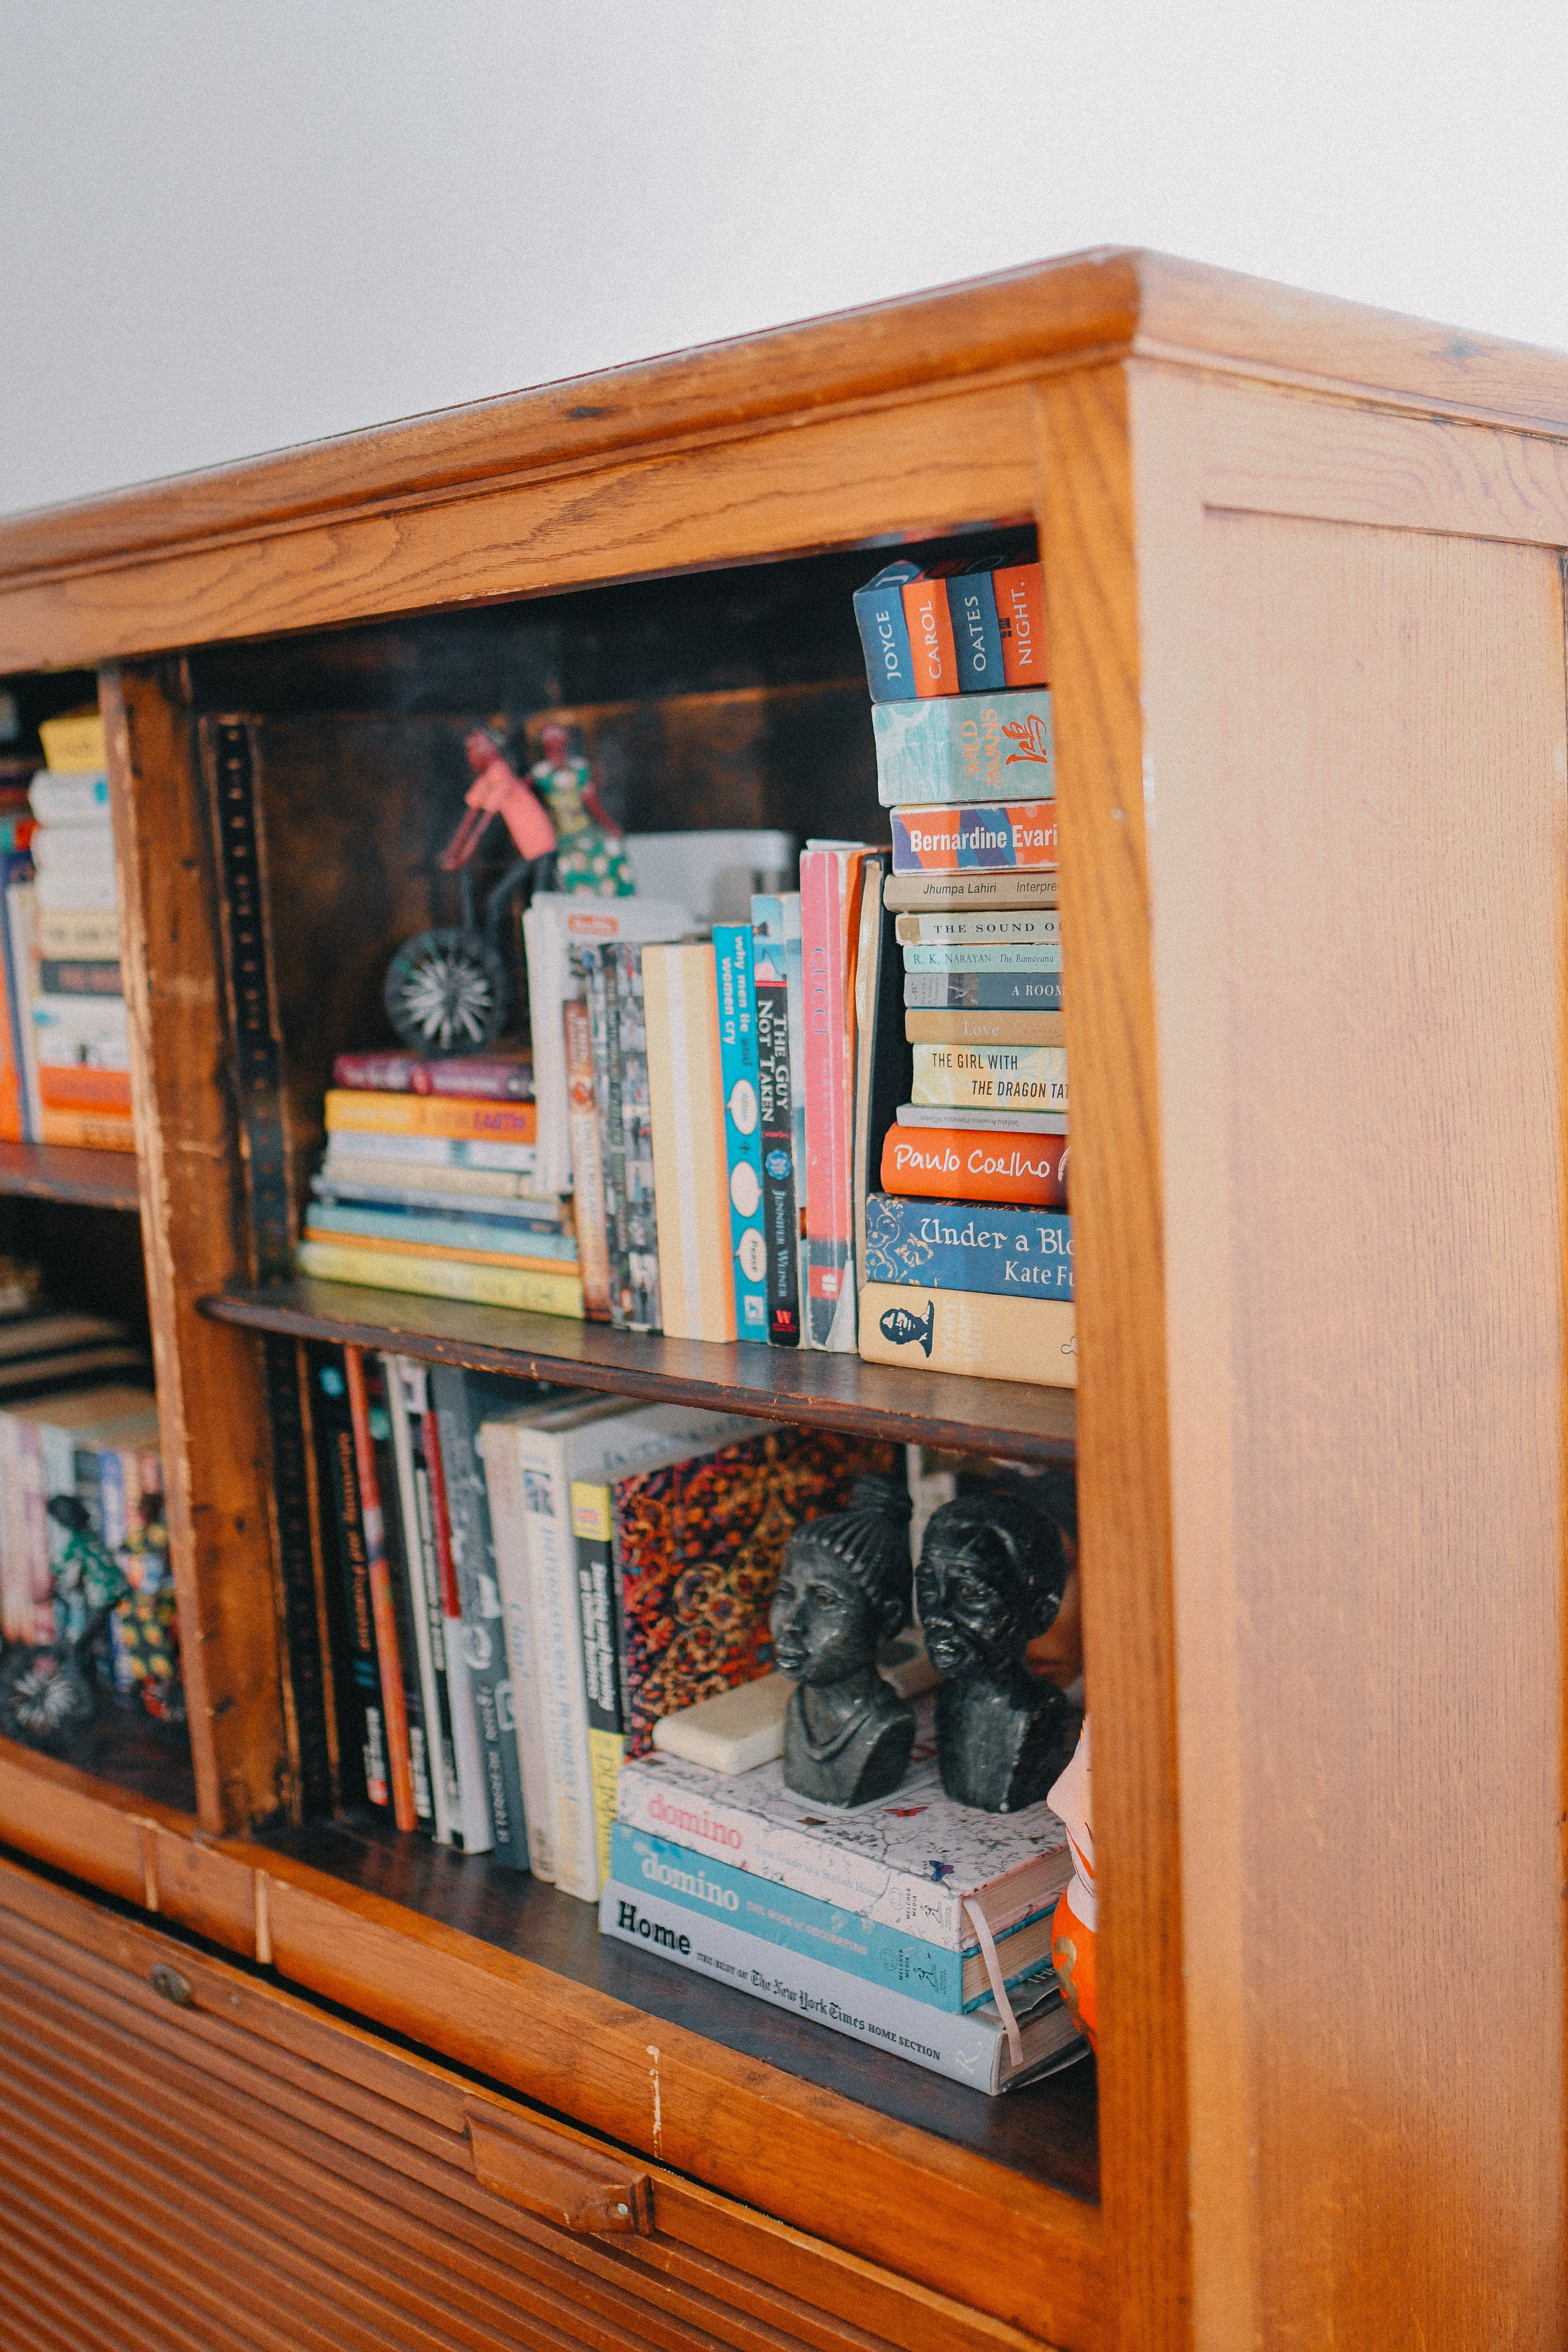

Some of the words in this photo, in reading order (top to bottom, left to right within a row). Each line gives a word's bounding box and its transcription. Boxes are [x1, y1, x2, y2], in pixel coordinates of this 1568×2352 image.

[919, 600, 942, 679] CAROL
[964, 595, 987, 671] OATES
[1011, 581, 1033, 666] NIGHT.
[876, 610, 902, 680] JOYCE
[961, 720, 979, 777] WILD
[981, 708, 1003, 786] SWANS
[910, 826, 1007, 852] Bernardine
[1012, 824, 1058, 847] Evari
[923, 884, 964, 896] Jhumpa
[968, 883, 997, 894] Lahiri
[1017, 882, 1057, 894] Interpre
[976, 924, 1034, 932] SOUND
[734, 935, 746, 970] why
[913, 954, 924, 964] R.
[930, 954, 940, 964] K.
[945, 954, 991, 964] NARAYAN
[1000, 954, 1012, 962] The
[1016, 954, 1054, 966] Ramayana
[722, 957, 734, 1015] women
[737, 975, 746, 1008] men
[810, 948, 827, 1034] GUCCI
[1012, 985, 1020, 996] A
[722, 1020, 735, 1044] cry
[740, 1012, 751, 1032] lie
[758, 1000, 773, 1047] NOT
[773, 1014, 787, 1057] THE
[963, 1022, 1000, 1036] Love
[932, 1053, 952, 1068] THE
[957, 1054, 984, 1069] GIRL
[988, 1055, 1017, 1070] WITH
[760, 1057, 775, 1122] TAKEN
[775, 1066, 789, 1109] GUY
[972, 1080, 992, 1095] THE
[998, 1082, 1046, 1098] DRAGON
[894, 1144, 960, 1172] Paulo
[967, 1150, 1050, 1178] Coelho
[920, 1218, 1008, 1250] Under
[1016, 1233, 1030, 1251] a
[1003, 1260, 1051, 1284] Kate
[648, 1793, 742, 1849] domino
[642, 1851, 739, 1911] domino
[618, 1901, 690, 1955] Home
[750, 1969, 772, 1991] The
[772, 1980, 801, 2001] New
[799, 1991, 827, 2015] York
[830, 2002, 865, 2030] Times
[868, 2022, 897, 2042] HOME
[899, 2037, 941, 2061] SECTION
